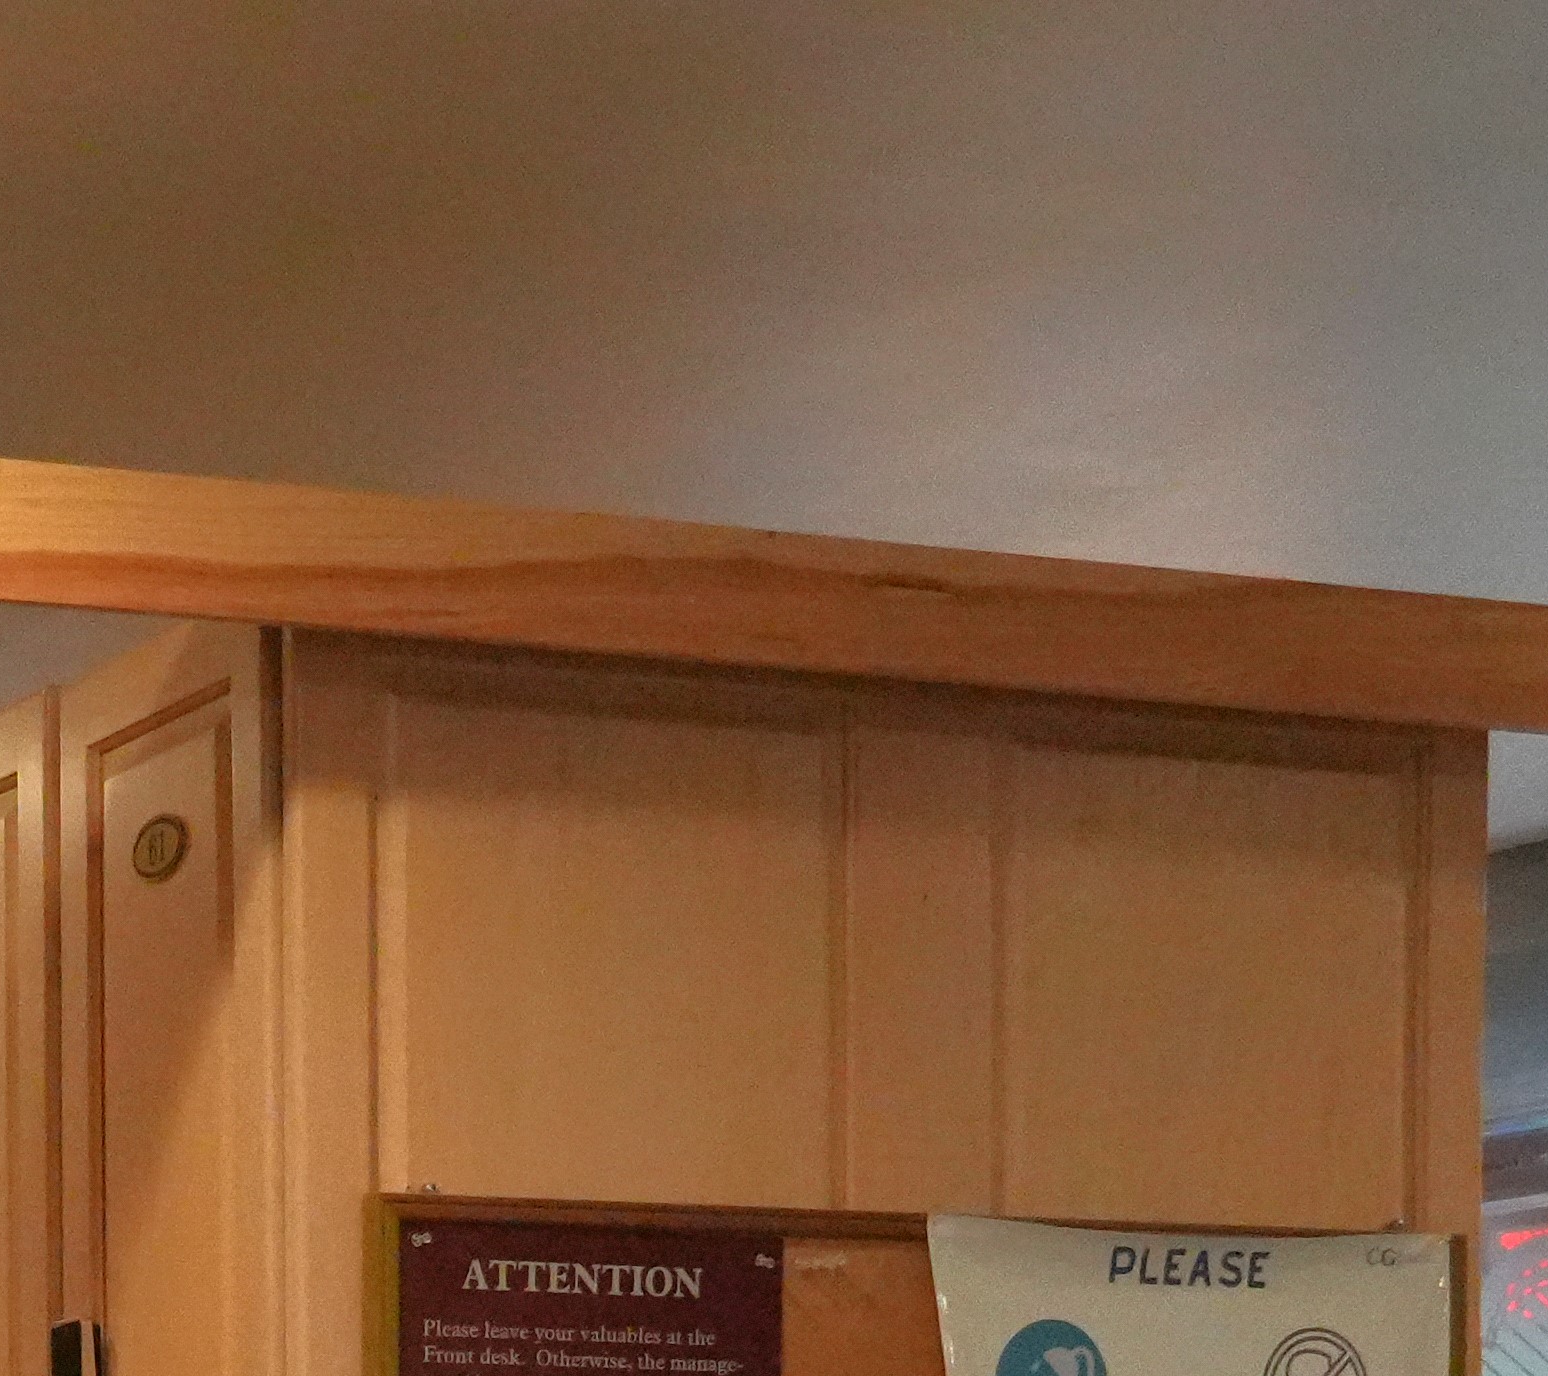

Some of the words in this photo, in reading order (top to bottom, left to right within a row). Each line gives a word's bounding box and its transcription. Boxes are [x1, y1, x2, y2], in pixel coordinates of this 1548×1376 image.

[462, 1258, 703, 1300] ATTENTION
[1108, 1246, 1270, 1289] PLEASE
[423, 1319, 478, 1339] Please
[485, 1321, 530, 1339] leave
[534, 1325, 574, 1343] your
[580, 1325, 661, 1345] valuables
[667, 1328, 682, 1345] at
[687, 1328, 715, 1346] the
[423, 1346, 473, 1364] Front
[480, 1348, 525, 1367] desk.
[536, 1349, 632, 1370] Otherwise,
[638, 1353, 665, 1370] the
[670, 1358, 744, 1375] manage-
